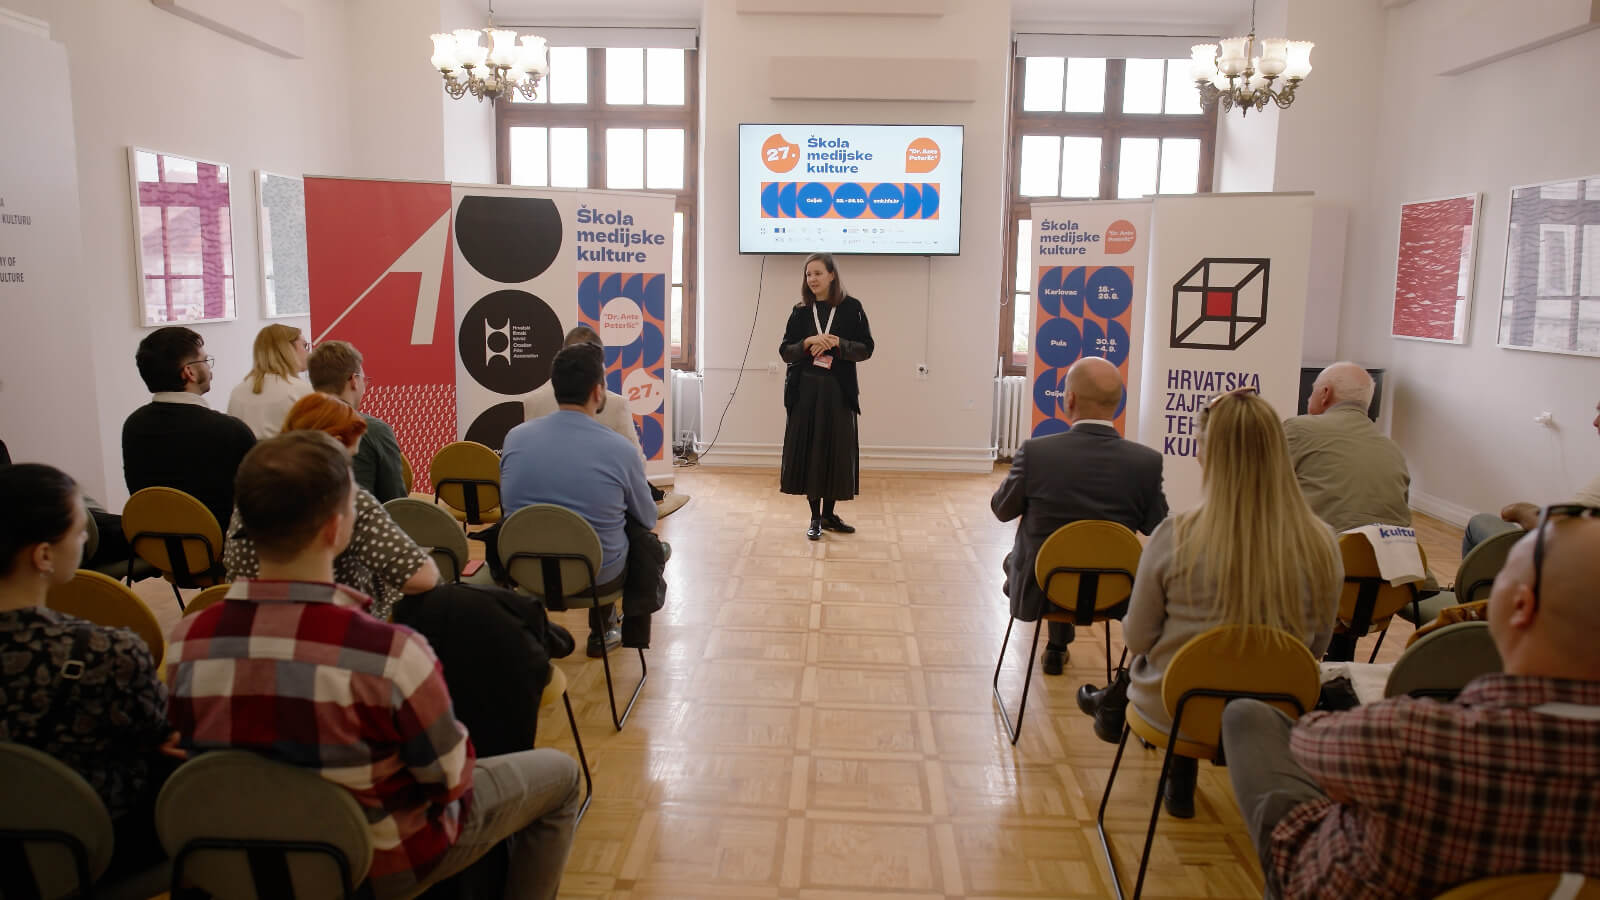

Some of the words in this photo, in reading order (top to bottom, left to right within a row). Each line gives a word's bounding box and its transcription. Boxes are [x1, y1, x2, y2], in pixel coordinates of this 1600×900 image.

[807, 134, 850, 148] Škola
[766, 146, 796, 162] 27.
[807, 149, 873, 163] medijske
[807, 162, 859, 174] kulture
[577, 204, 634, 226] Škola
[1041, 219, 1079, 231] Škola
[577, 228, 665, 248] medijske
[1040, 232, 1100, 245] medijske
[577, 245, 647, 263] kulture
[1040, 245, 1087, 255] kulture
[8, 257, 16, 267] OF
[1167, 369, 1260, 396] HRVATSKA
[628, 384, 660, 401] 27.
[1379, 528, 1416, 538] kultu
